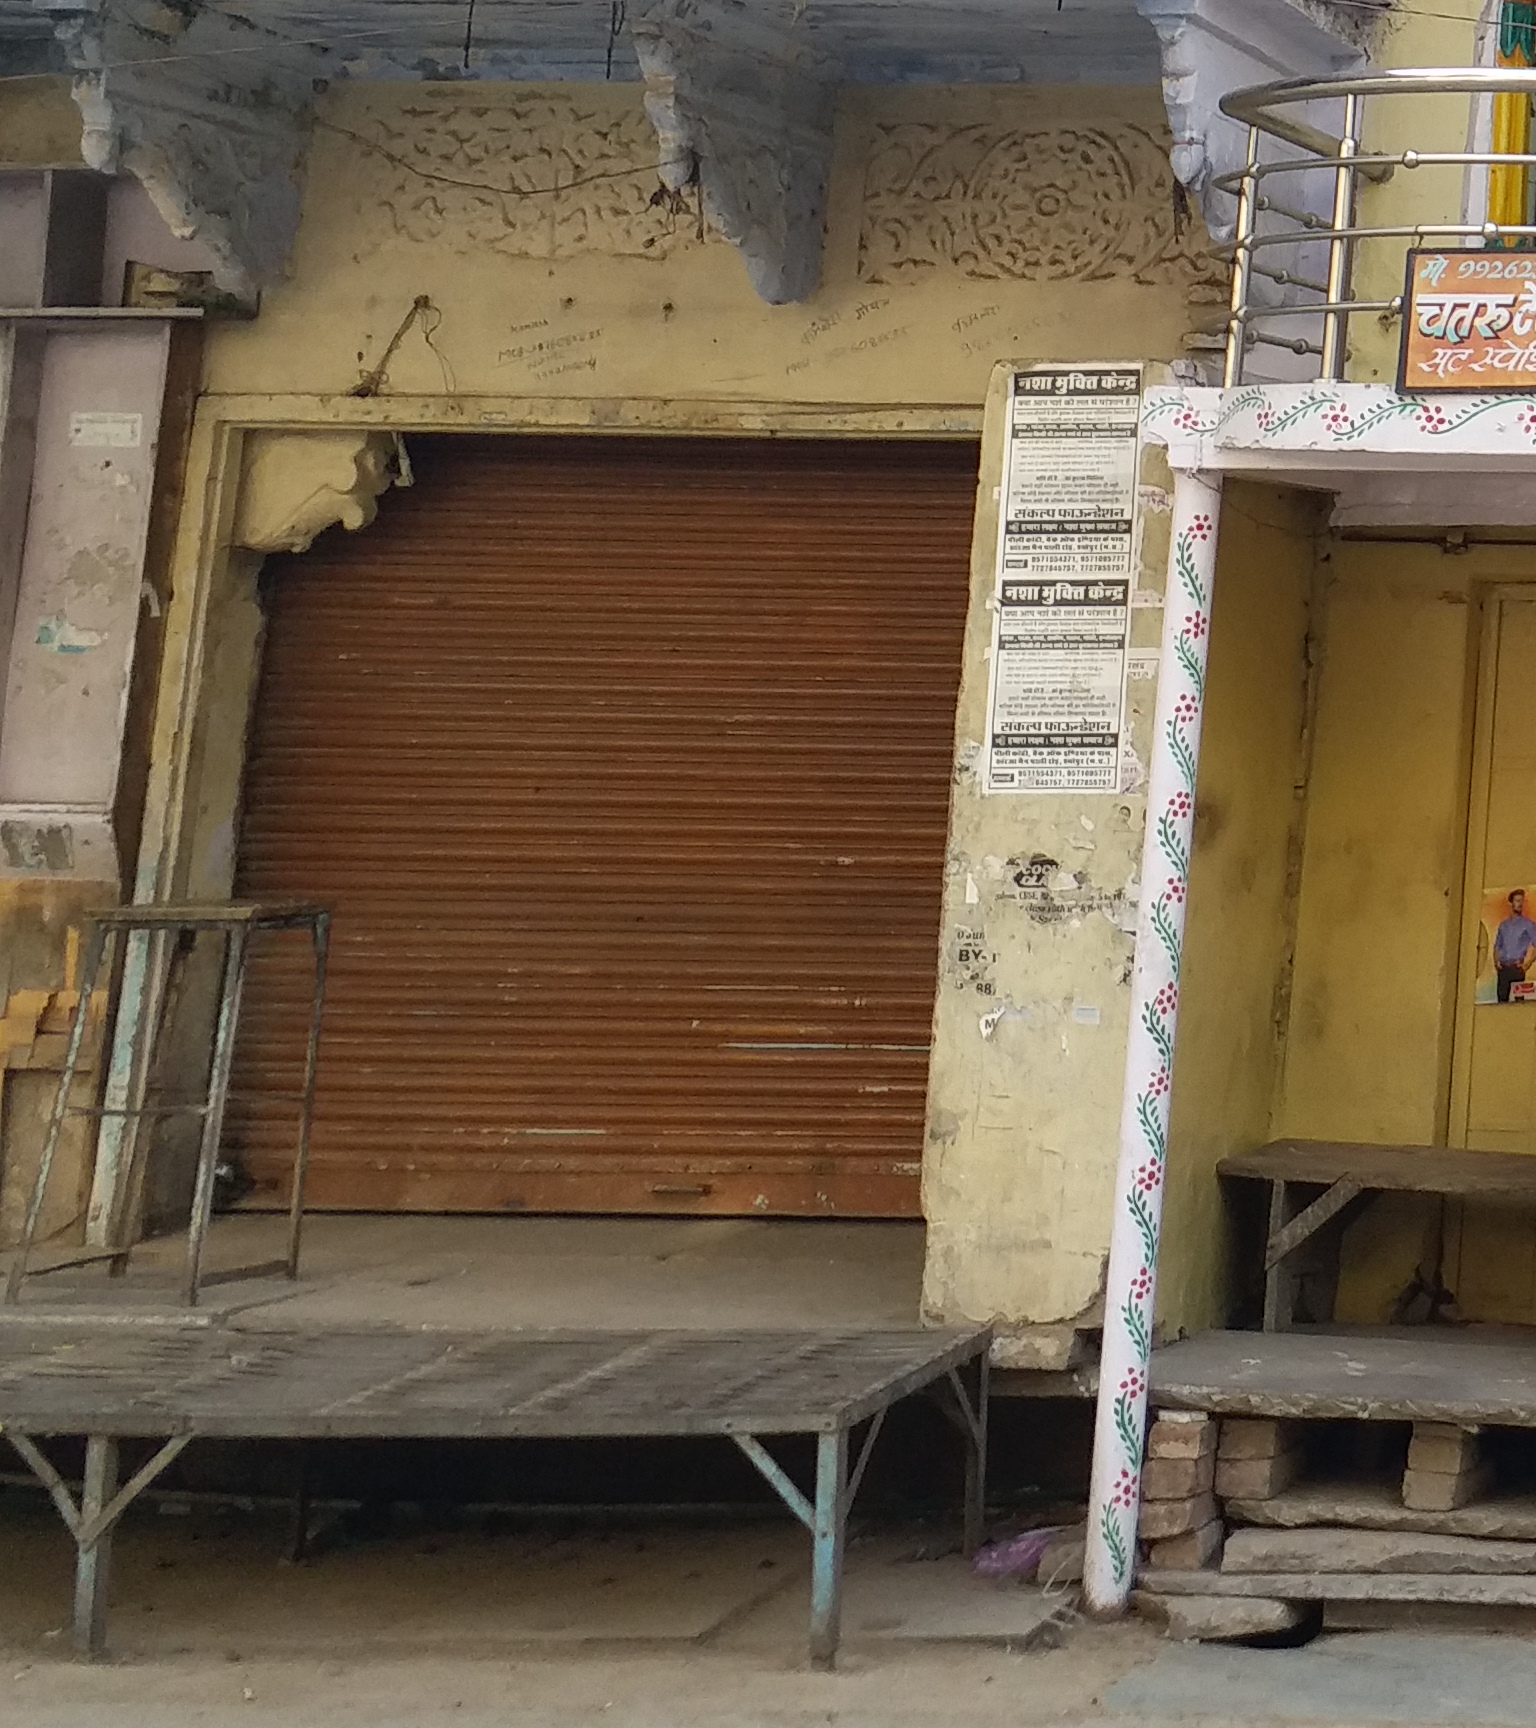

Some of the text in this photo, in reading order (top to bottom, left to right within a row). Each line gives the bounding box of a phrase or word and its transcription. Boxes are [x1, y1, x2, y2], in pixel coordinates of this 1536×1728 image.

[1018, 371, 1138, 395] नशा मुक्ति केन्द्र
[1014, 506, 1056, 519] संकल्प
[1005, 582, 1125, 605] नशा मुक्ति केन्द्र
[1000, 719, 1042, 732] संकल्प
